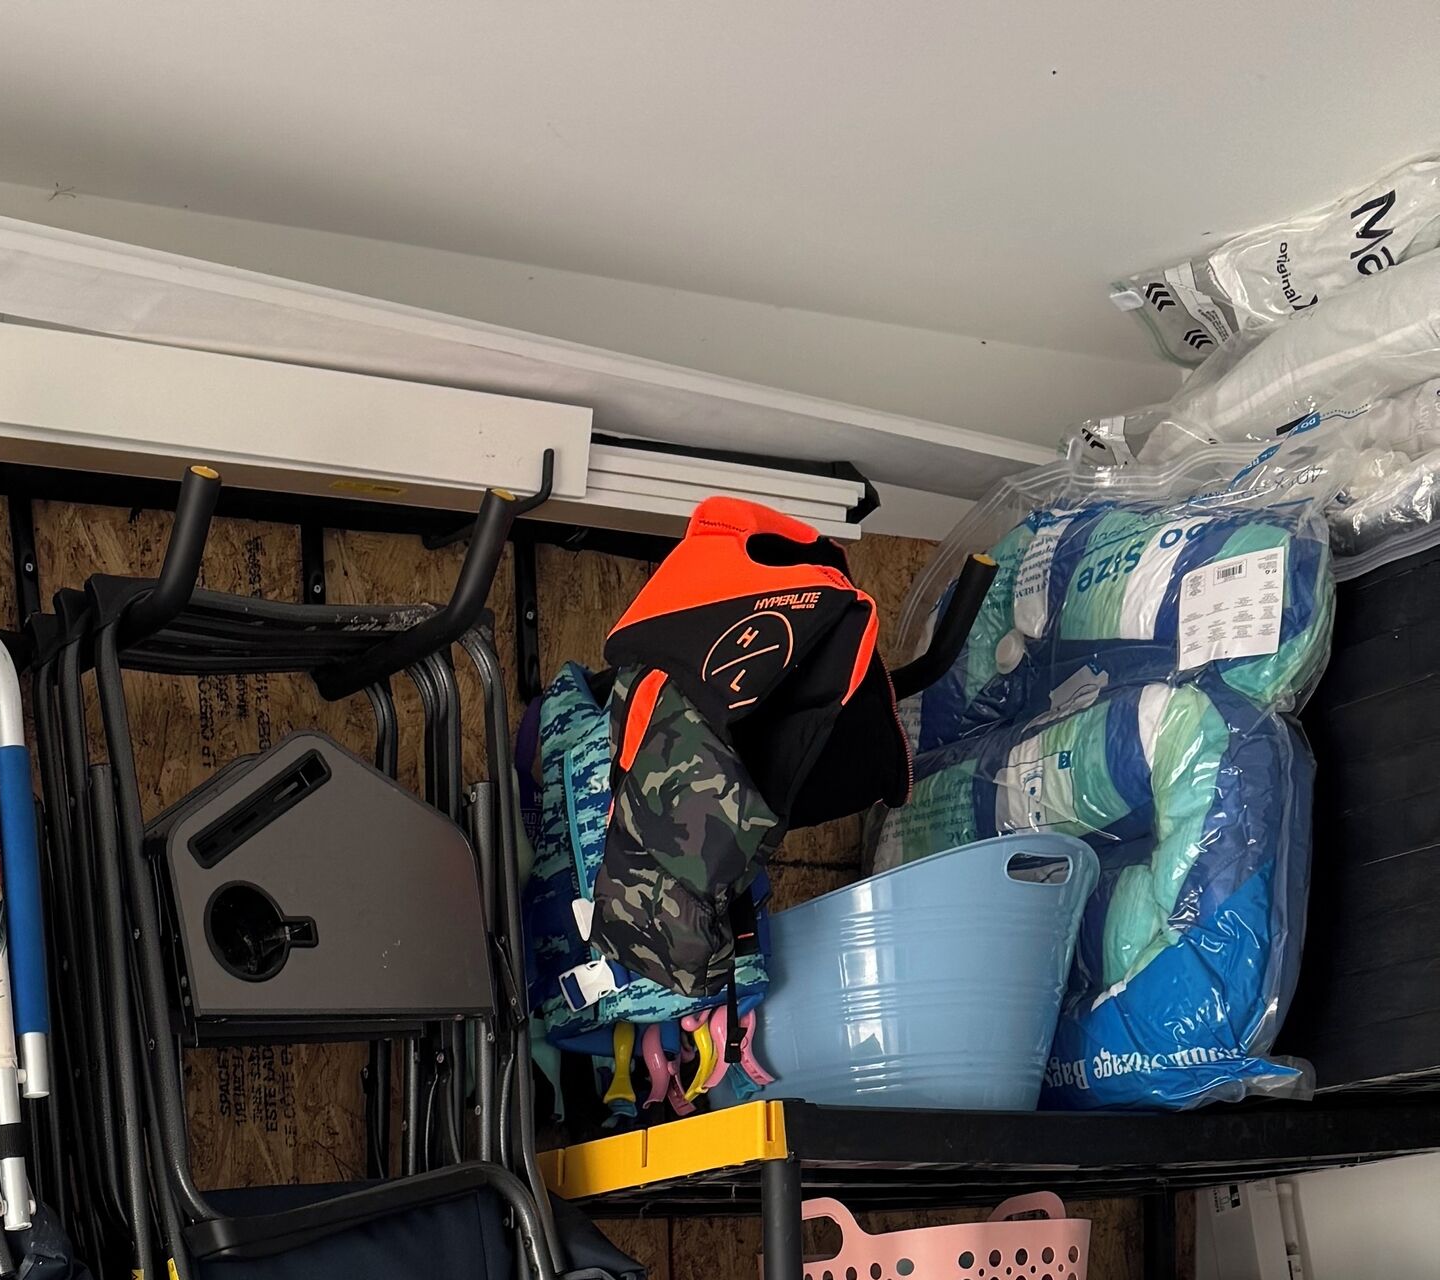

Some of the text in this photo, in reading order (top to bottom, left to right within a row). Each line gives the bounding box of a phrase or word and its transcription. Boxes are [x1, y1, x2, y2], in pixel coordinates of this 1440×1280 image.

[1276, 242, 1302, 303] original
[1076, 540, 1147, 593] Size
[753, 592, 821, 611] HYPERLITE
[736, 626, 759, 648] H
[730, 668, 746, 692] L
